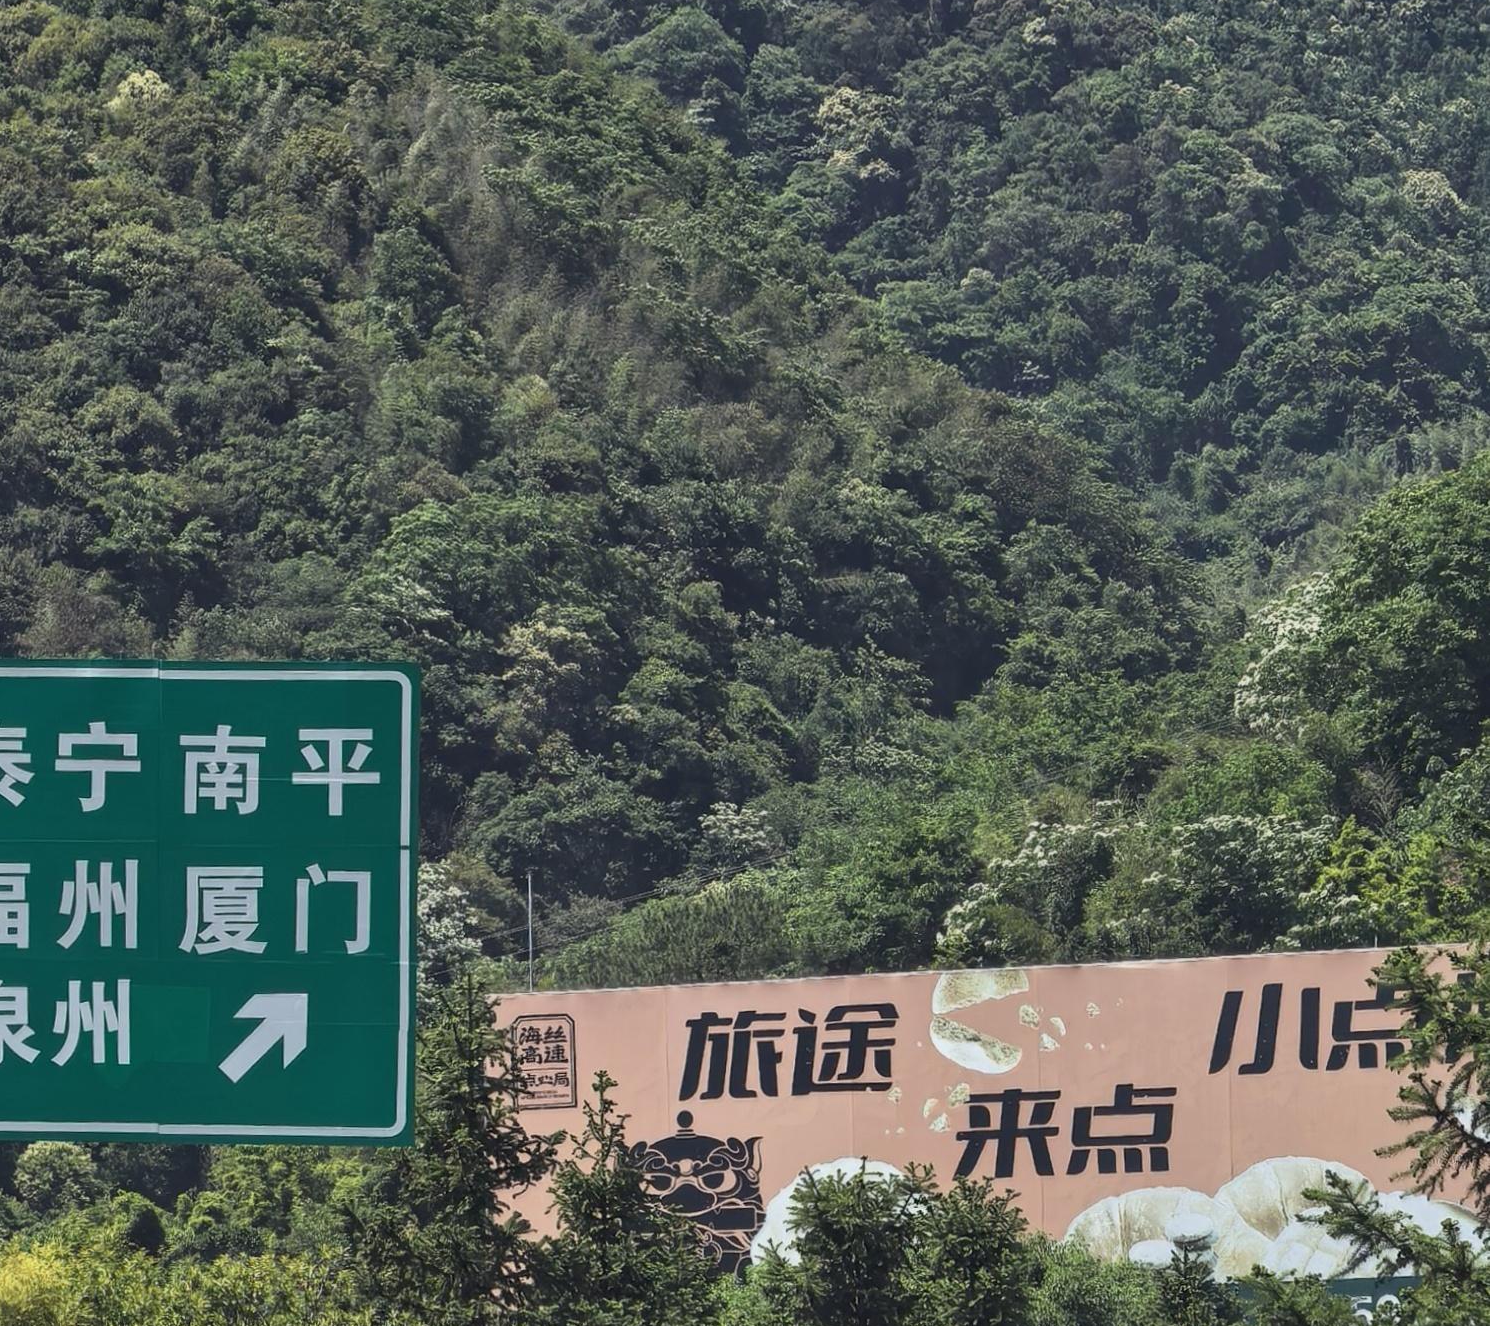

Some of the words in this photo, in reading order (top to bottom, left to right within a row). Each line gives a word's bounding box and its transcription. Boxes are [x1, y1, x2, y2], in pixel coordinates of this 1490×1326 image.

[179, 724, 380, 816] 南平
[179, 863, 372, 955] 厦门
[678, 1002, 900, 1101] 旅途
[953, 1083, 1177, 1181] 来点
